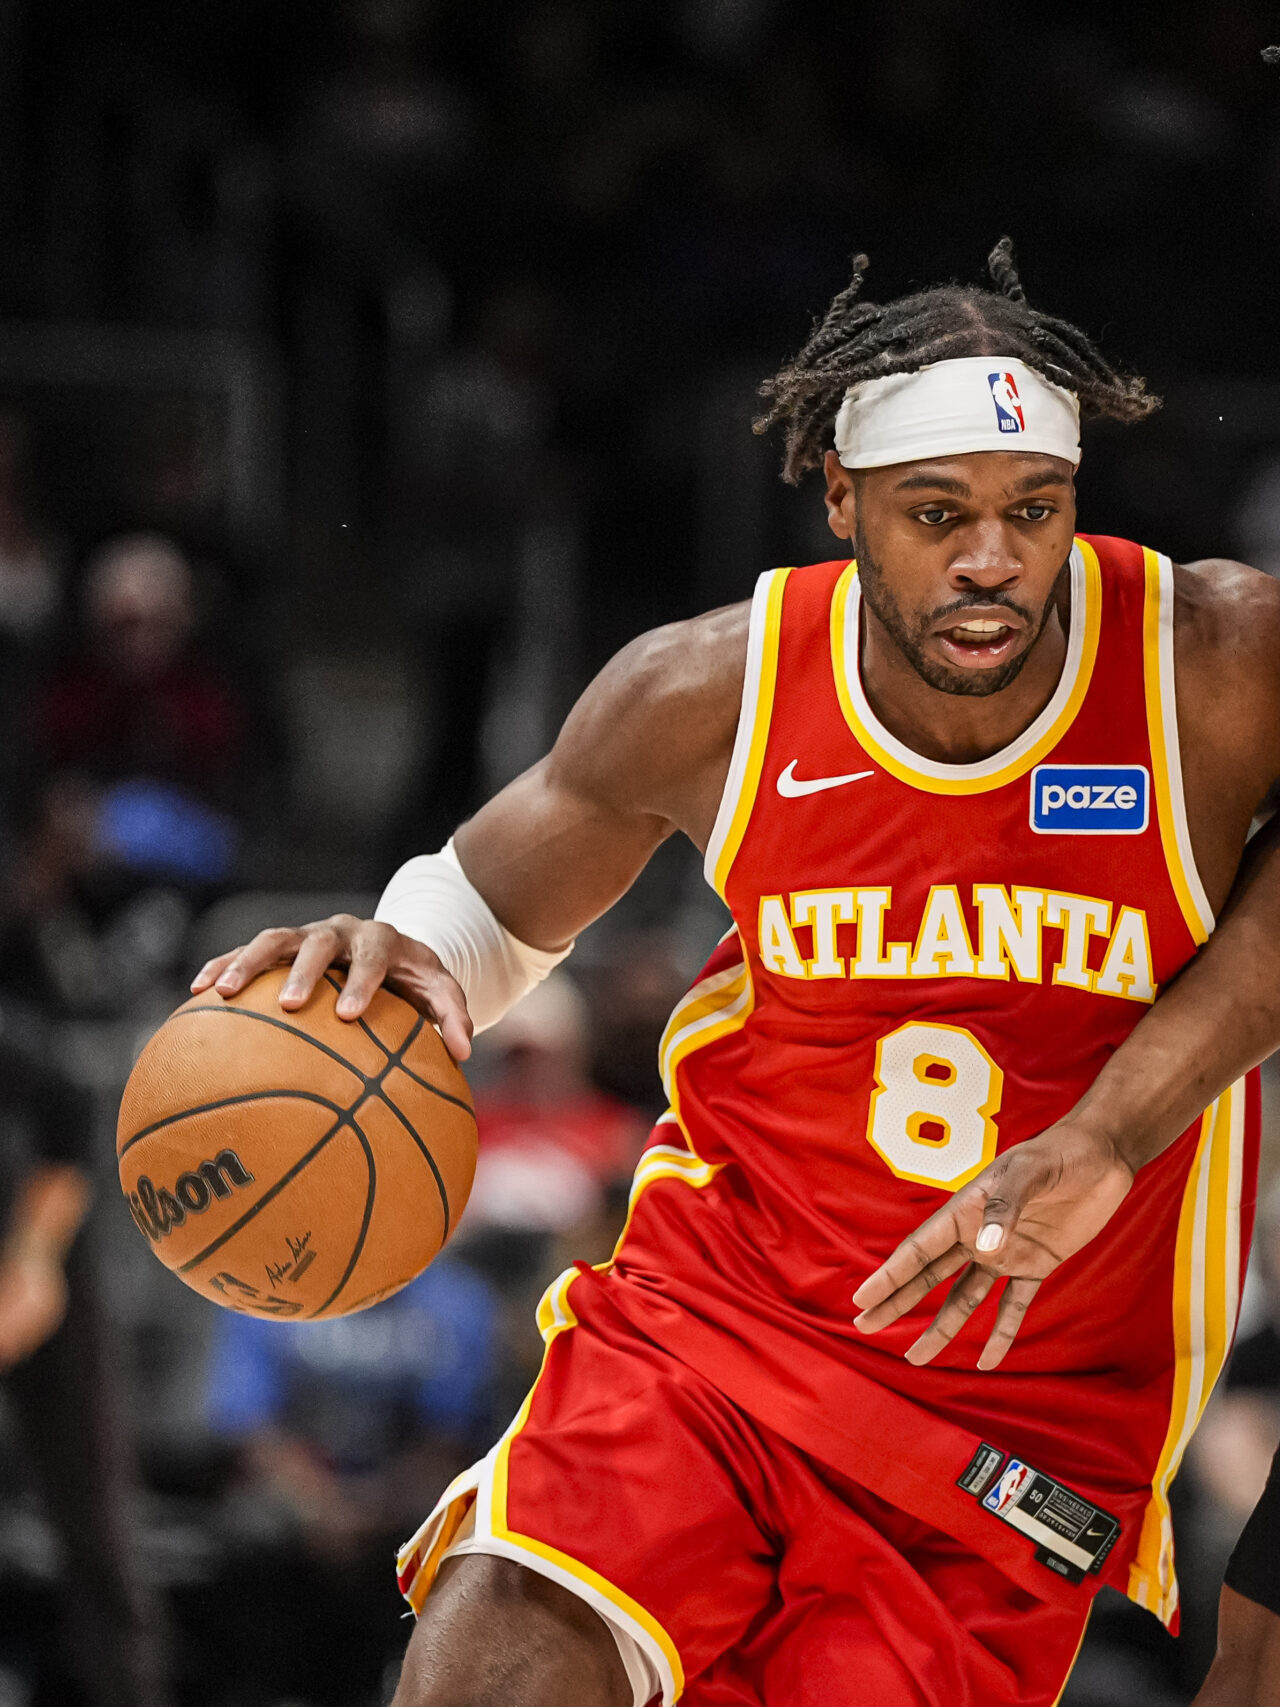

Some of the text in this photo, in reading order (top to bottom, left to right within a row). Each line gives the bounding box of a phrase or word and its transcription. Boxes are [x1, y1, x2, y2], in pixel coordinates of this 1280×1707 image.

[1001, 418, 1017, 431] NBA
[1041, 784, 1138, 816] paze
[758, 883, 1158, 1004] ATLANTA
[866, 1020, 1004, 1192] 8
[124, 1148, 256, 1244] ilson
[1028, 1488, 1044, 1504] 50
